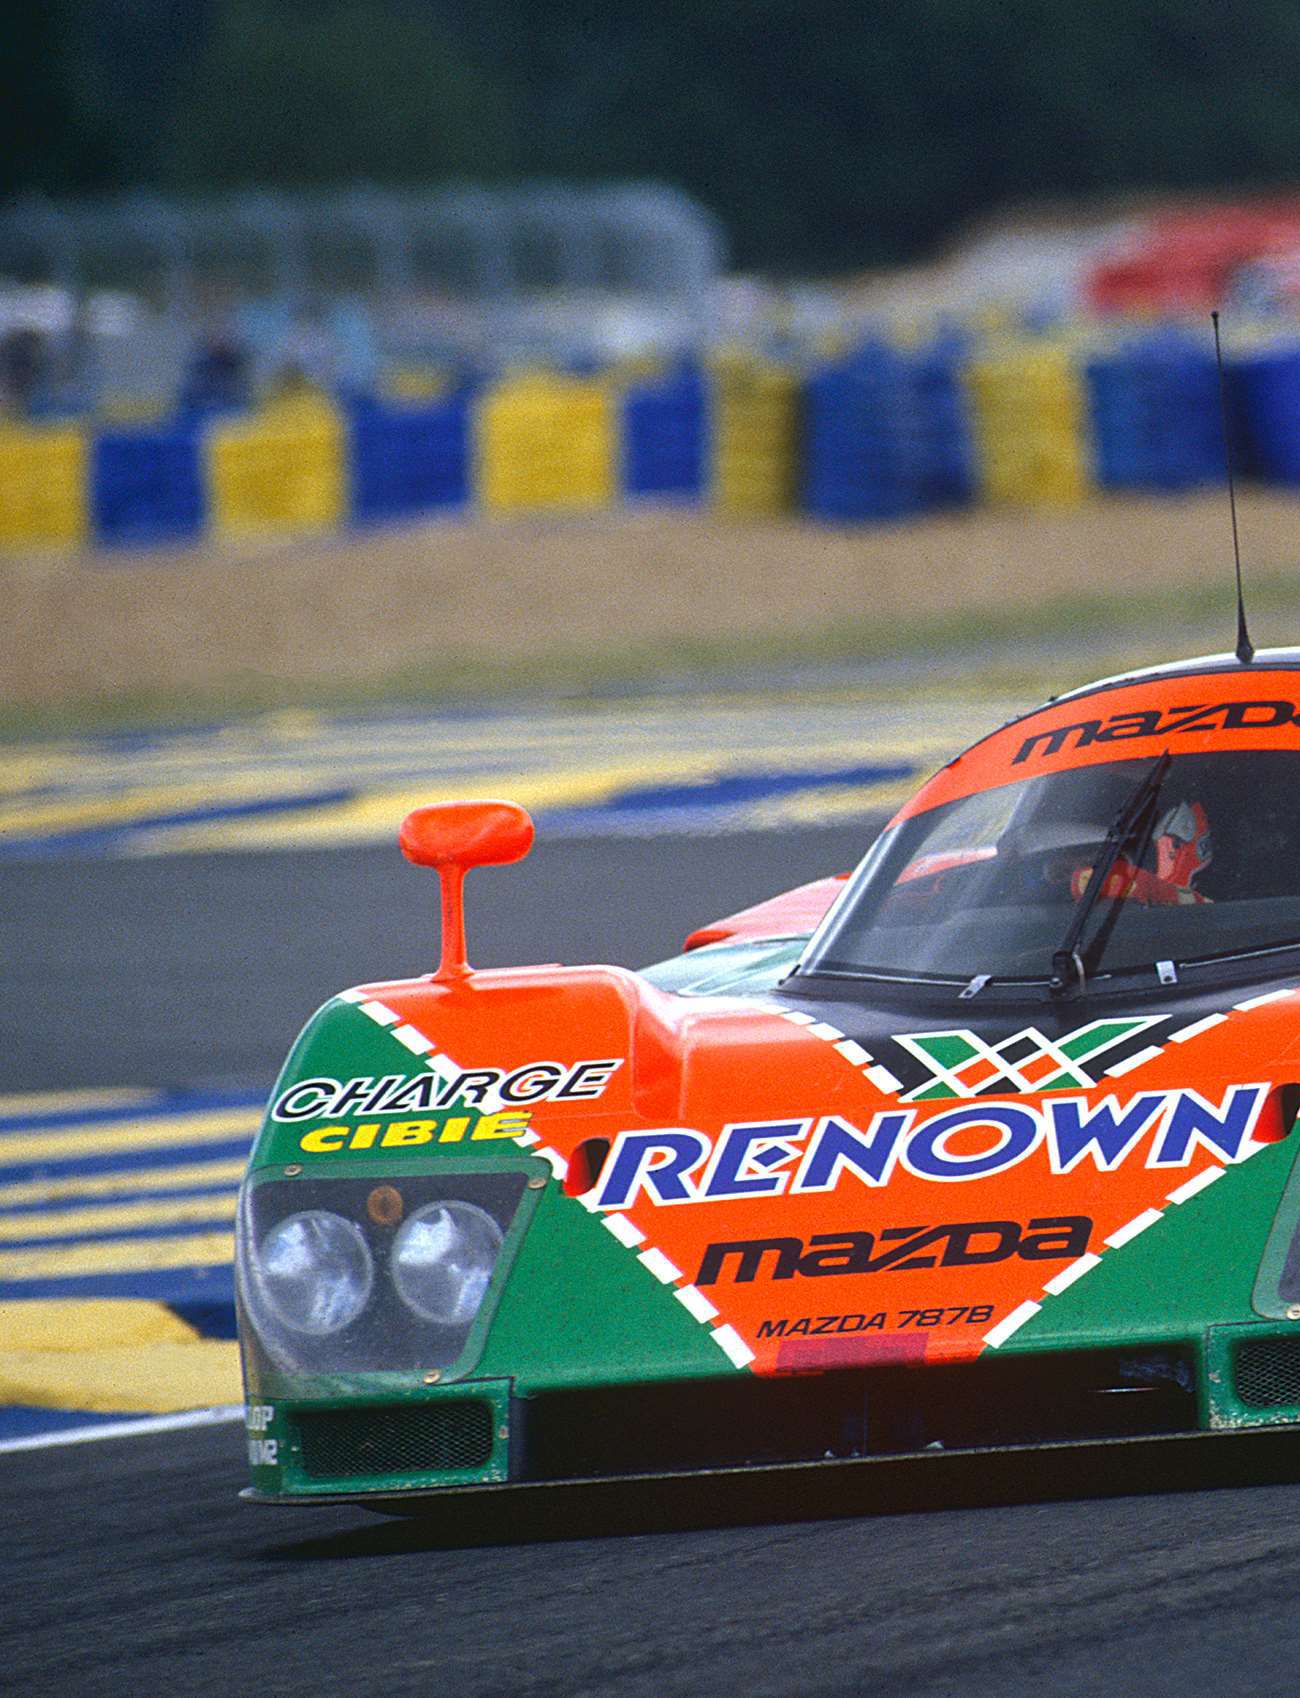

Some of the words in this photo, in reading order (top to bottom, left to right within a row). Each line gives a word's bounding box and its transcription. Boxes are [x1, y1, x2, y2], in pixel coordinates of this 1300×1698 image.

[271, 1058, 624, 1122] CHARGE
[586, 1082, 1271, 1213] RENOWN
[756, 1312, 888, 1339] MAZDA
